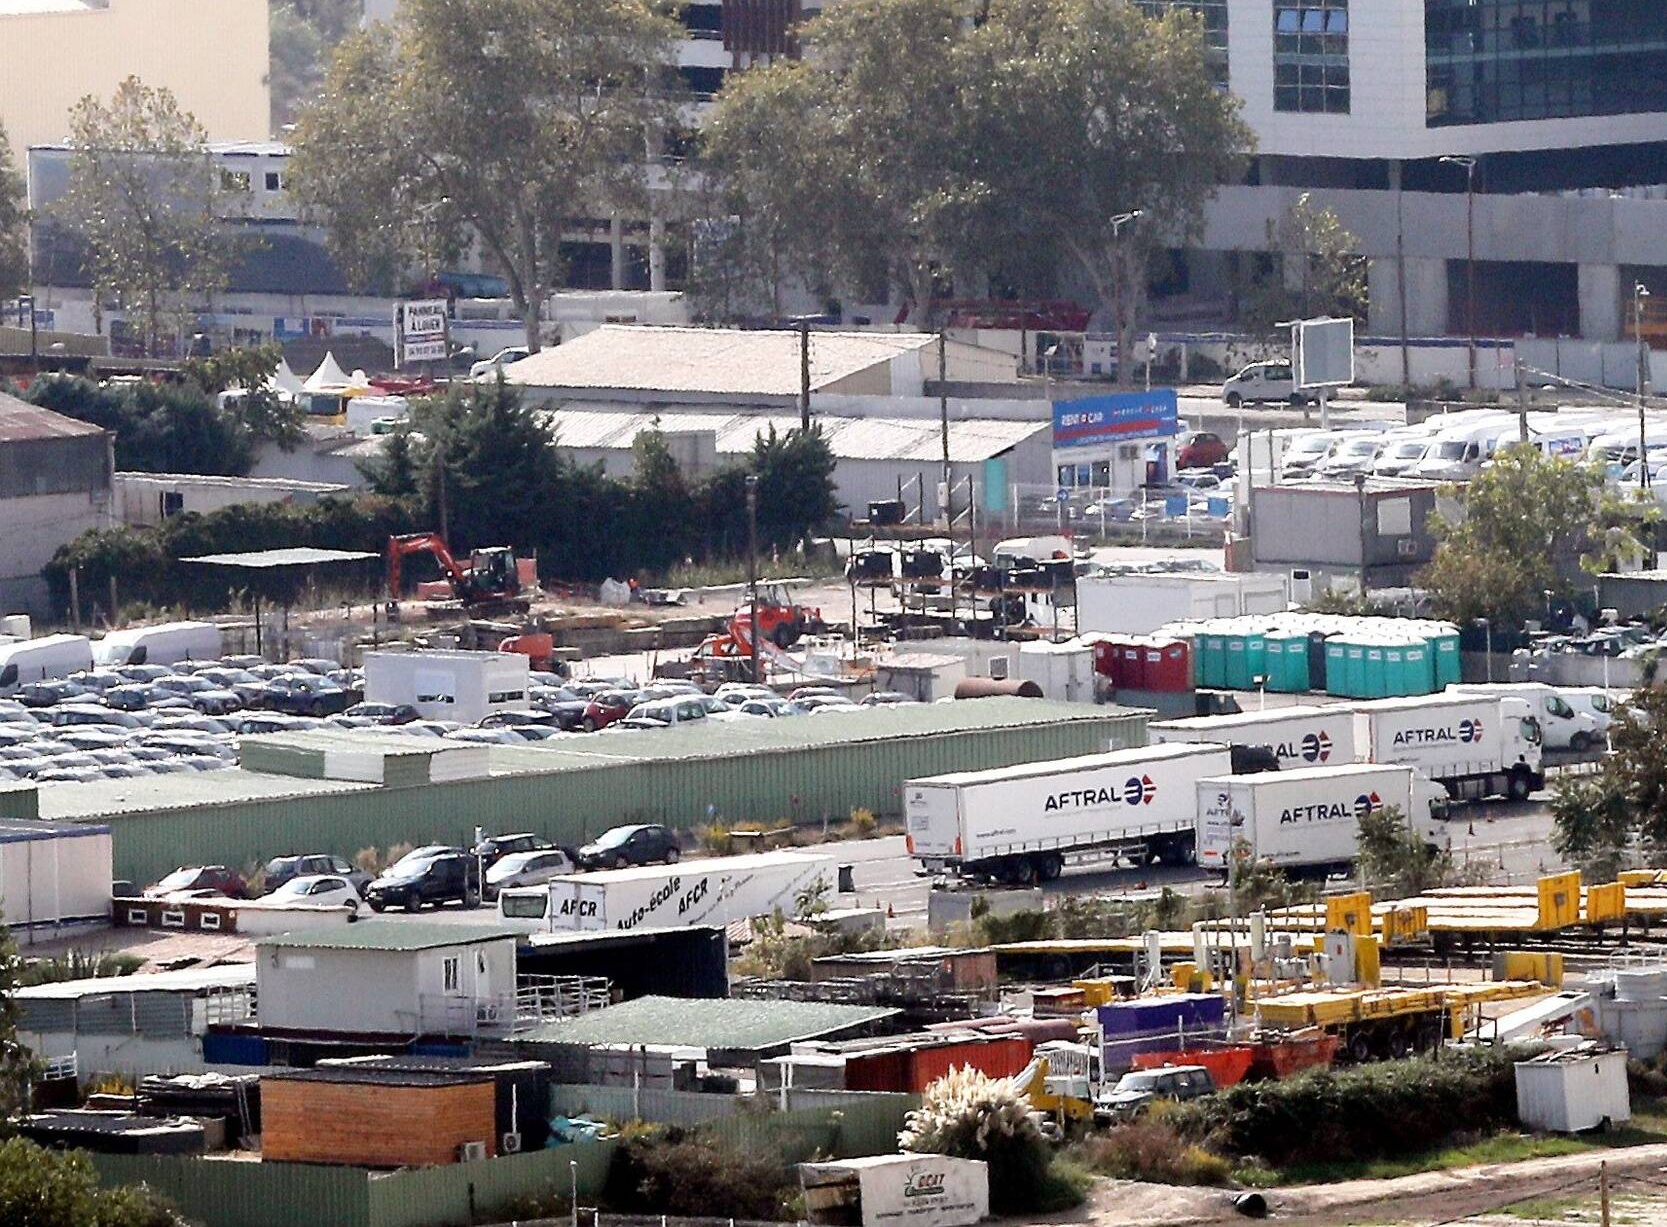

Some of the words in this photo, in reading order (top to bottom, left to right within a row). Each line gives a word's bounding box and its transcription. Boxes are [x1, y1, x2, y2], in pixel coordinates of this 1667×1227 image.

[1392, 726, 1457, 746] AFTRAL
[1044, 786, 1122, 812] AFTRAL
[1279, 803, 1352, 825] AFTRAL
[560, 898, 598, 917] AFCR
[678, 877, 709, 917] AFCR
